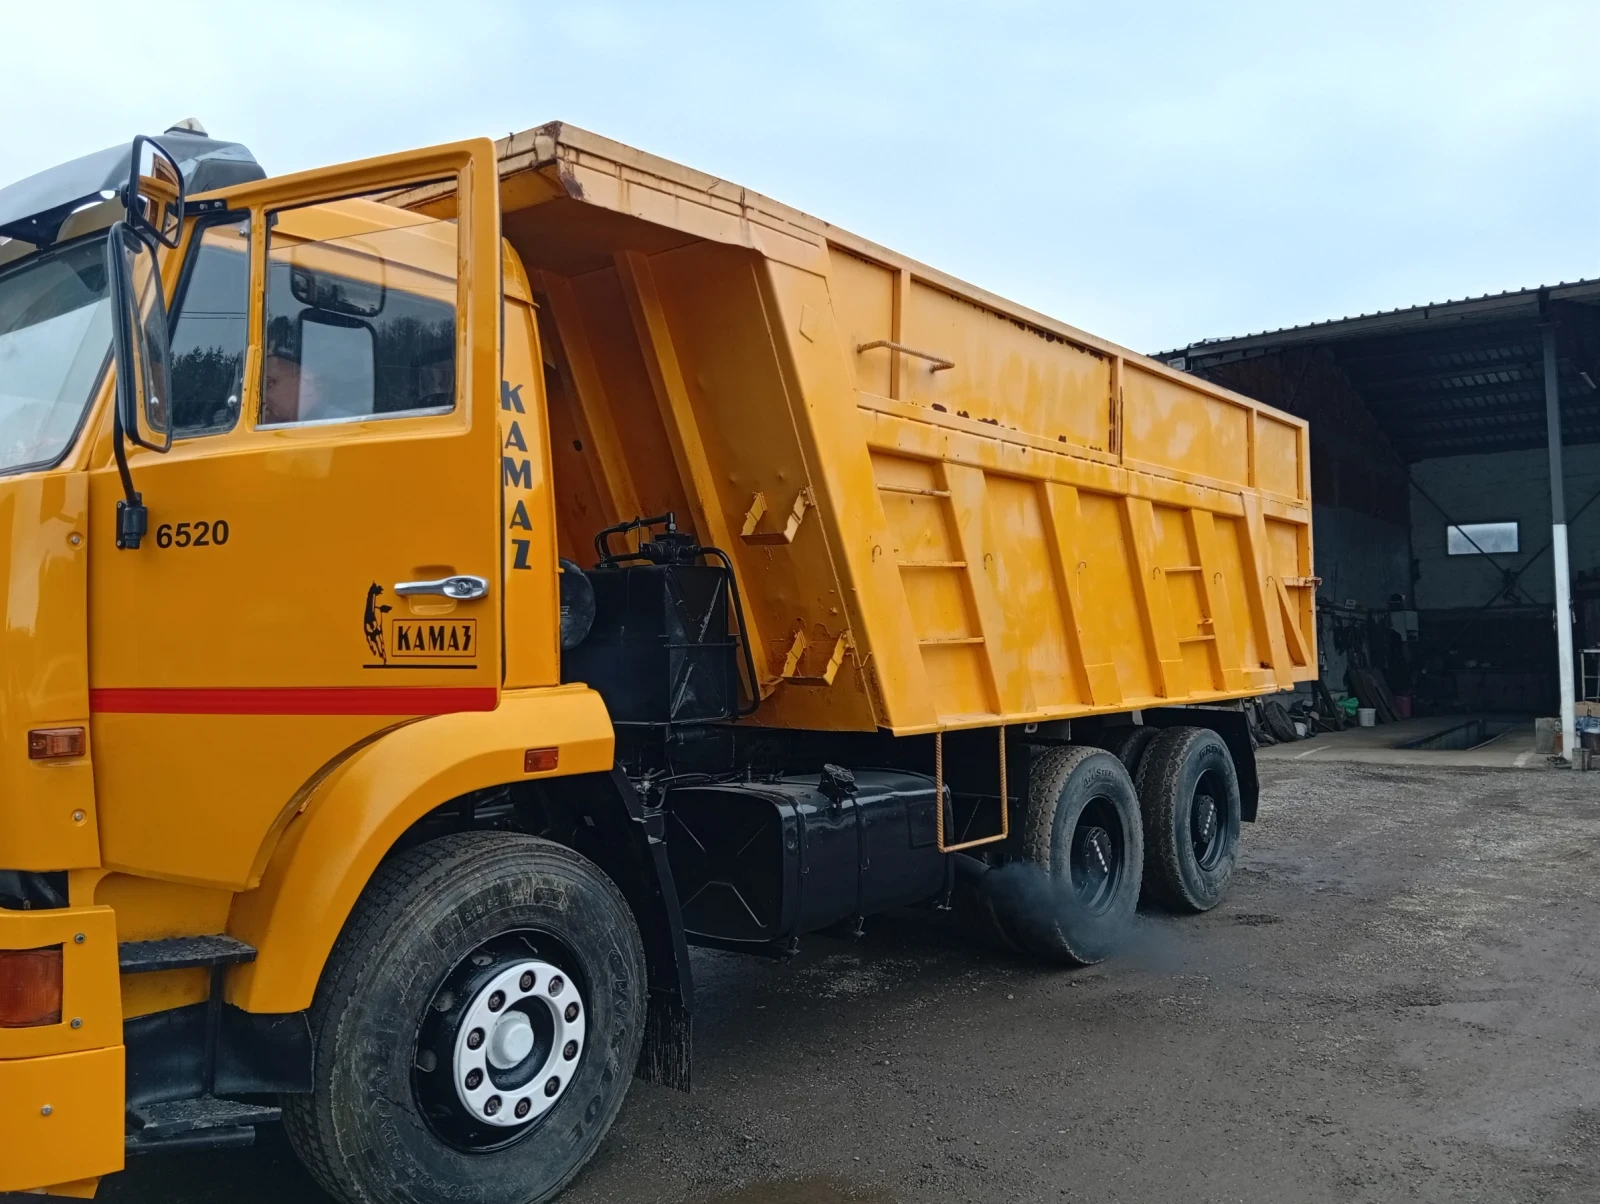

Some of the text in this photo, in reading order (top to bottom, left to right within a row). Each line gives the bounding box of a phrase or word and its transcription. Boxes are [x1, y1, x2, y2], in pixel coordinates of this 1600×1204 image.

[501, 380, 533, 570] KAMAZ
[156, 519, 229, 549] 6520
[397, 625, 471, 651] КАМАЗ
